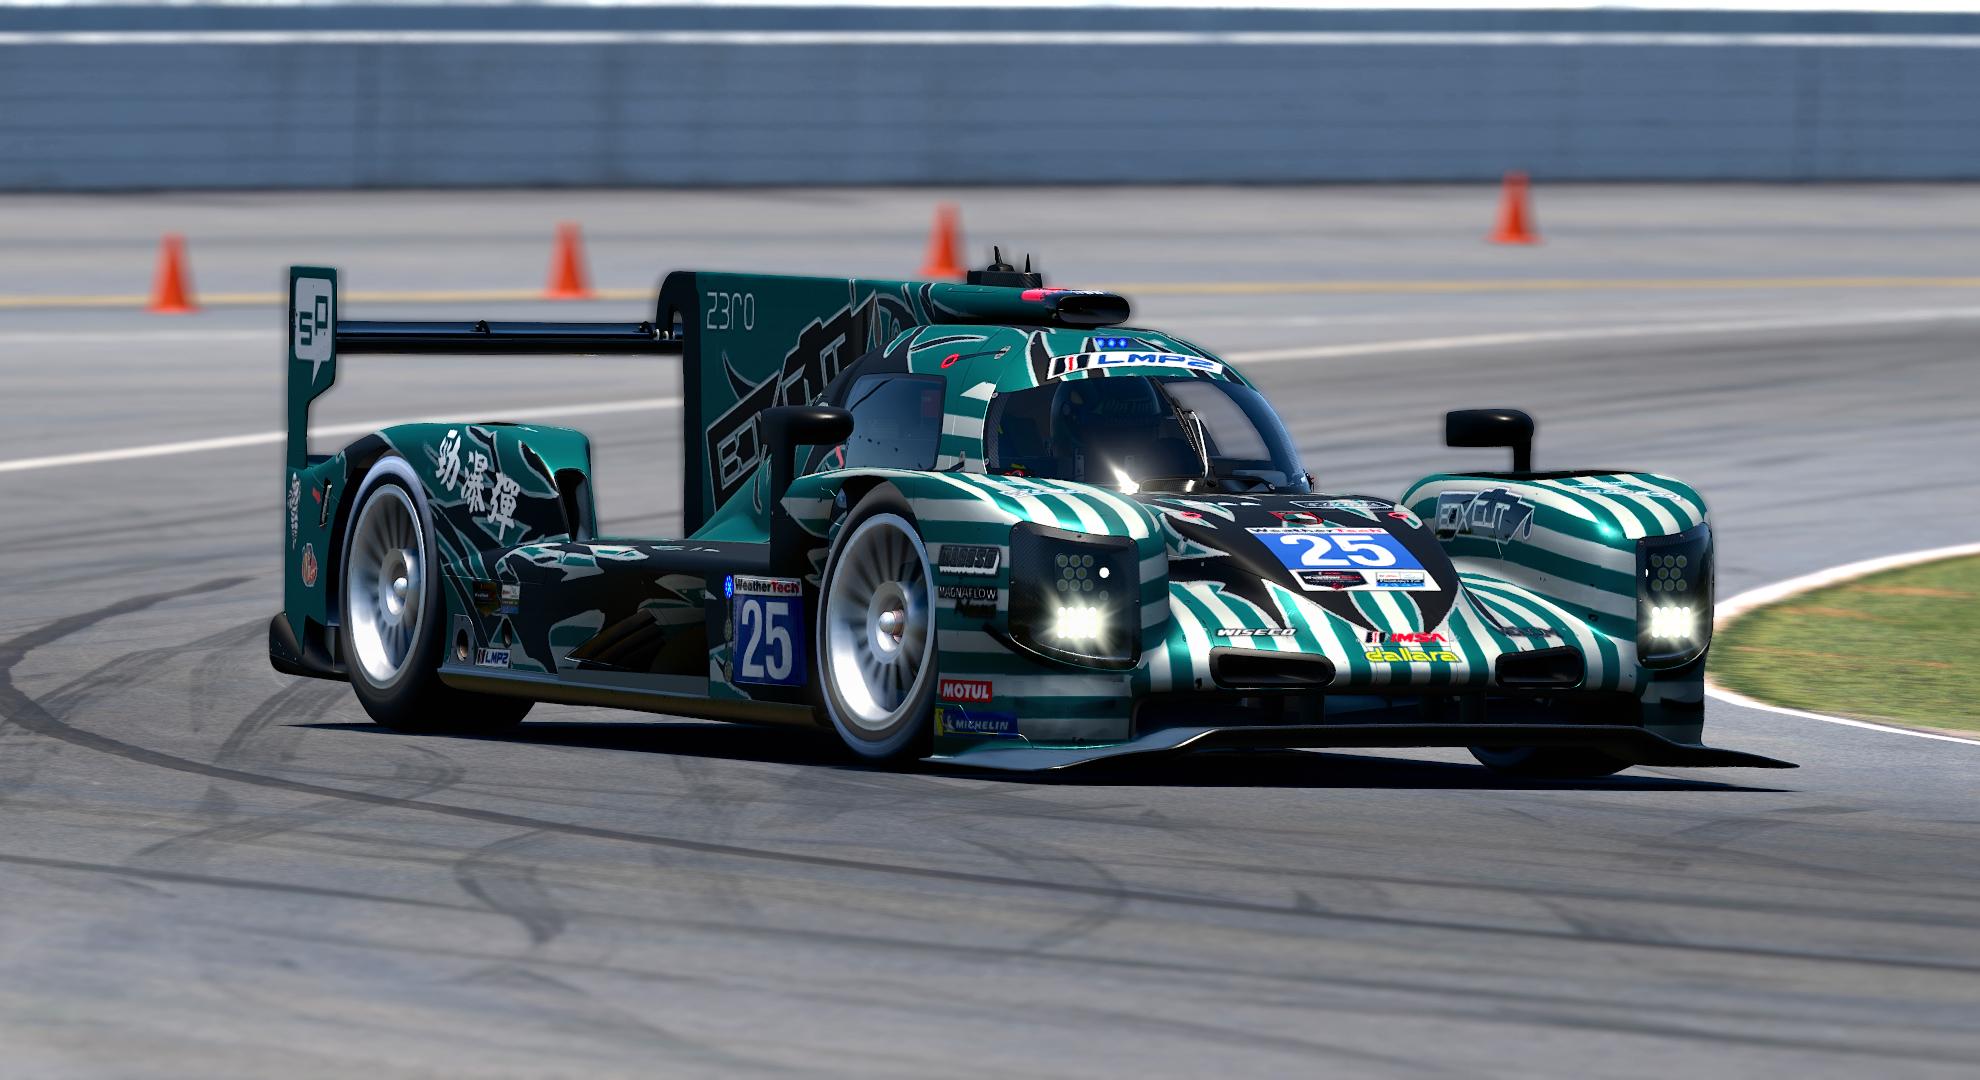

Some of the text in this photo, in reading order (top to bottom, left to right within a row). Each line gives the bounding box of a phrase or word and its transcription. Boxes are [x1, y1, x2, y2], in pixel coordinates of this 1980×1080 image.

[1097, 353, 1215, 369] LMP2
[1280, 535, 1397, 567] 25
[735, 578, 800, 594] WeatherTech
[742, 600, 793, 680] 25
[1217, 628, 1297, 637] WISECO
[1390, 632, 1448, 643] IMSA
[485, 651, 509, 664] LMP2
[1365, 647, 1462, 663] dallara
[943, 682, 990, 700] MOTUL
[955, 719, 1009, 731] MICHELIN
